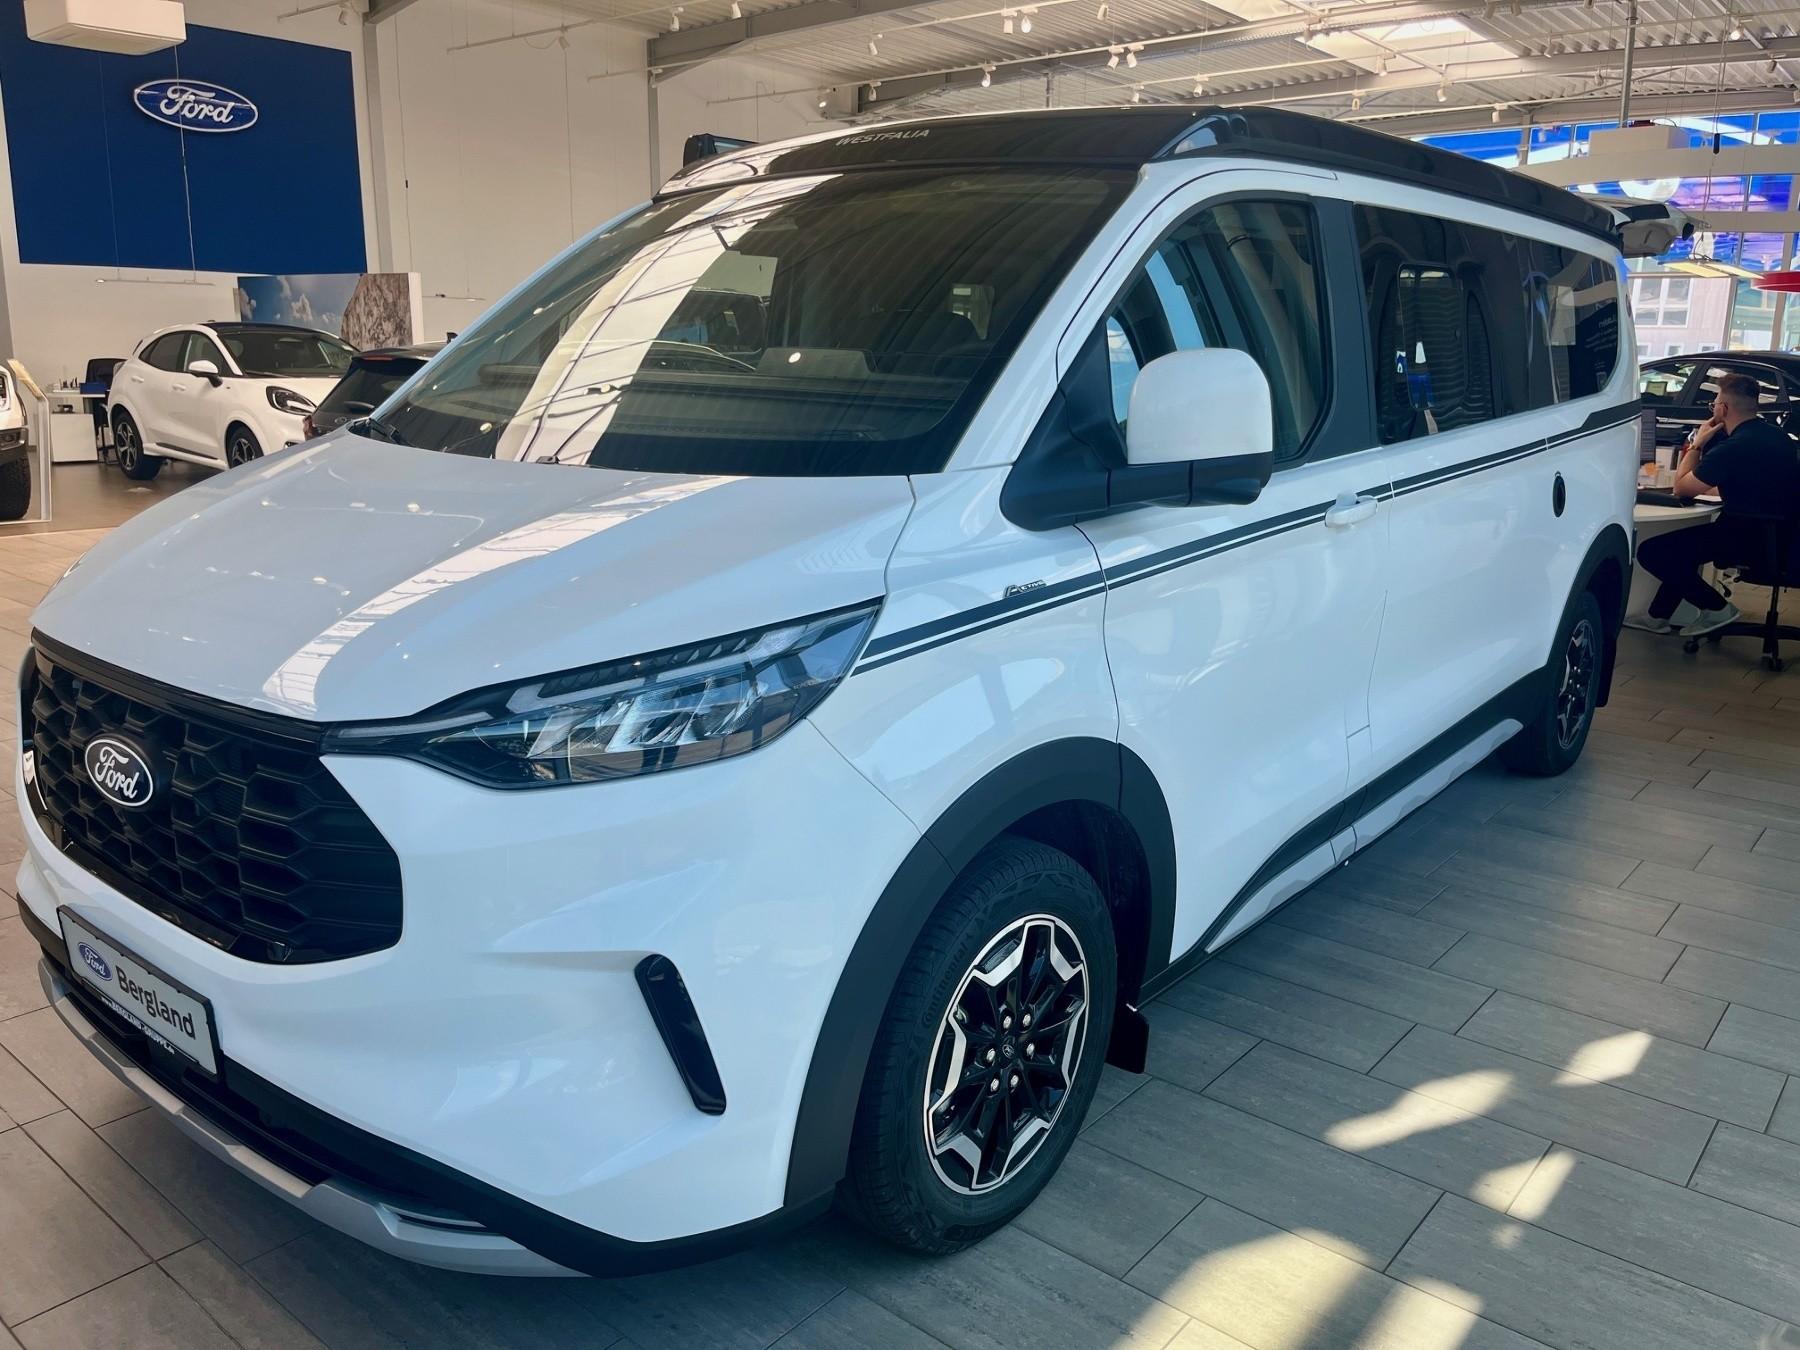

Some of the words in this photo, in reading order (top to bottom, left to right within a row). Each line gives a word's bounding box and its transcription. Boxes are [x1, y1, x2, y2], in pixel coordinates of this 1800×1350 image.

[160, 86, 234, 124] Ford
[835, 129, 930, 147] WESTFALIA
[94, 746, 140, 799] Ford
[84, 946, 107, 977] Ford
[115, 965, 196, 1040] Bergland
